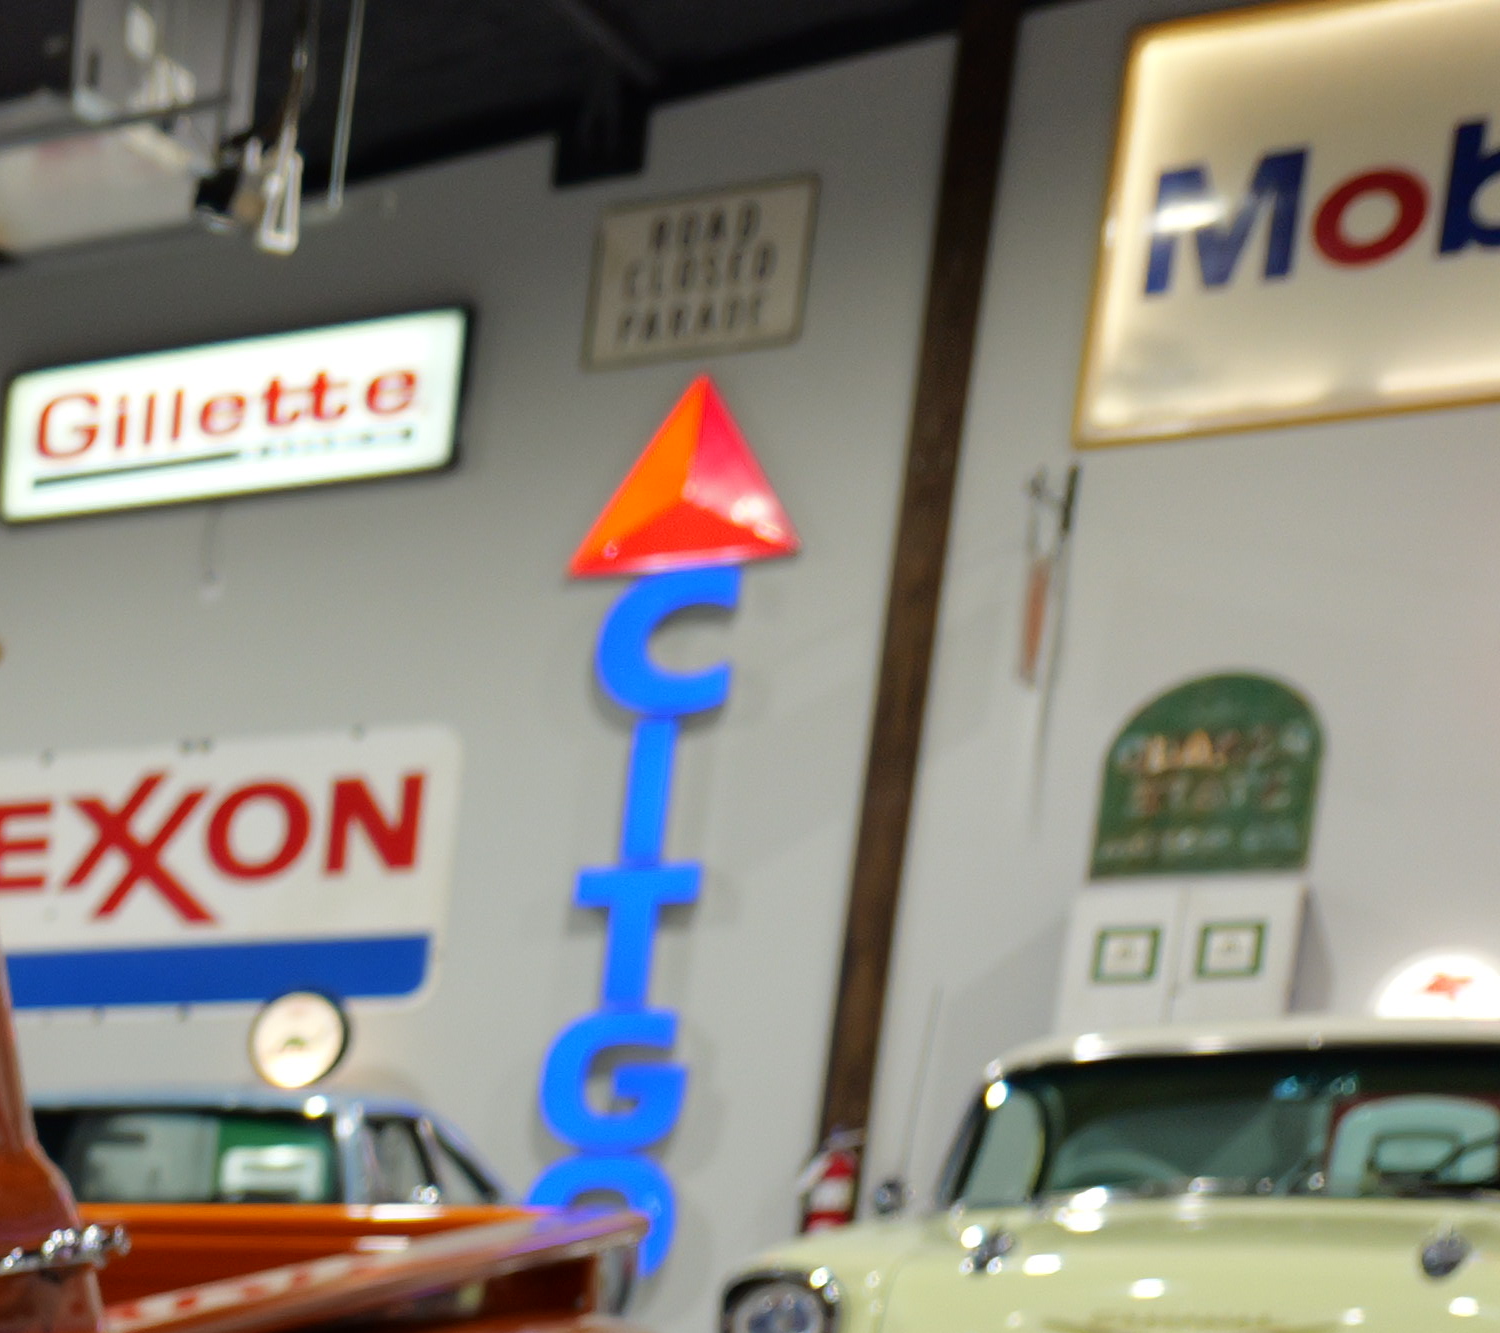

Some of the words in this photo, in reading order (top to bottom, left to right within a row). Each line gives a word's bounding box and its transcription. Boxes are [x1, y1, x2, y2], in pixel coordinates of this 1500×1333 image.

[649, 199, 761, 253] ROAD
[622, 240, 778, 299] CLOSED
[615, 288, 766, 348] PARADE
[36, 370, 417, 459] Gillette
